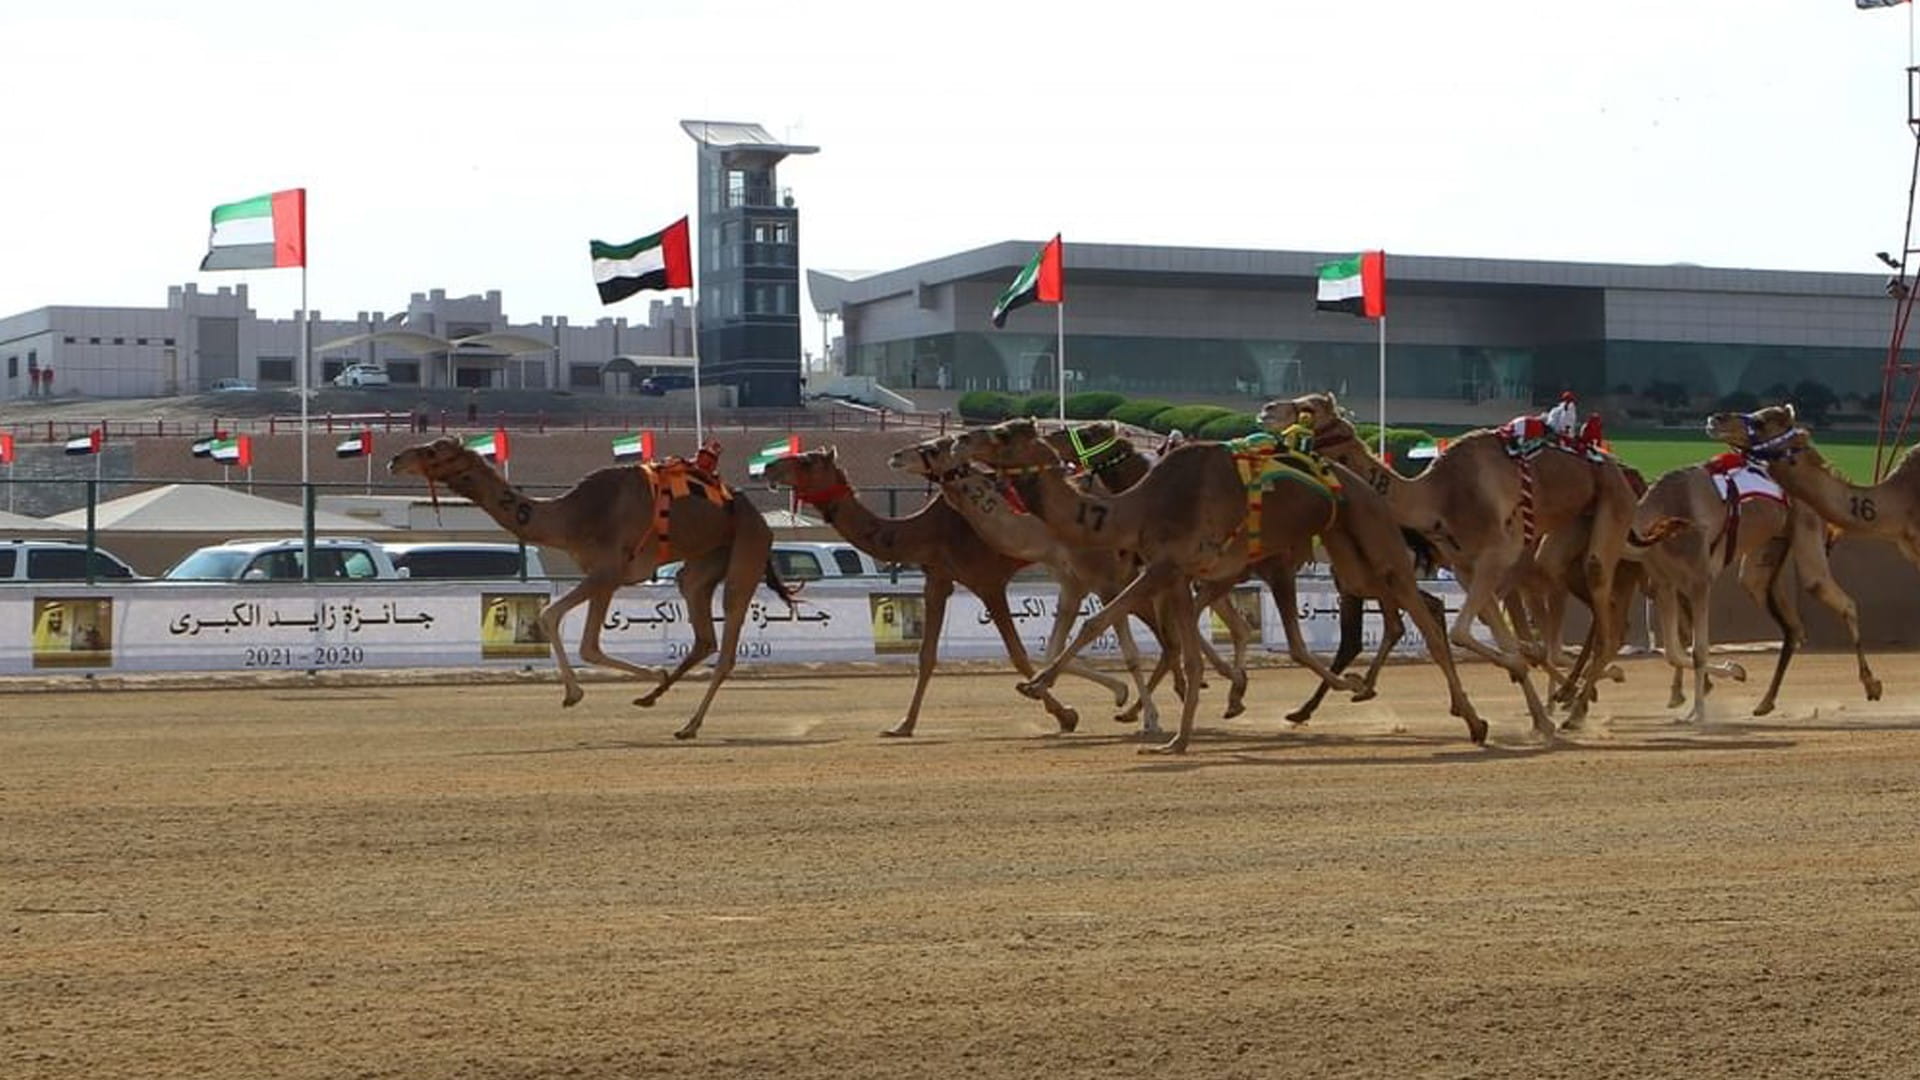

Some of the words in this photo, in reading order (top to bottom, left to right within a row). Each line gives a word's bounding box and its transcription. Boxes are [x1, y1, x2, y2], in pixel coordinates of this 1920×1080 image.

[498, 489, 532, 526] 26
[1076, 502, 1108, 531] 17
[1850, 496, 1877, 521] 16
[169, 602, 261, 636] الكبرى
[245, 648, 291, 666] 2021
[315, 647, 364, 665] 2020
